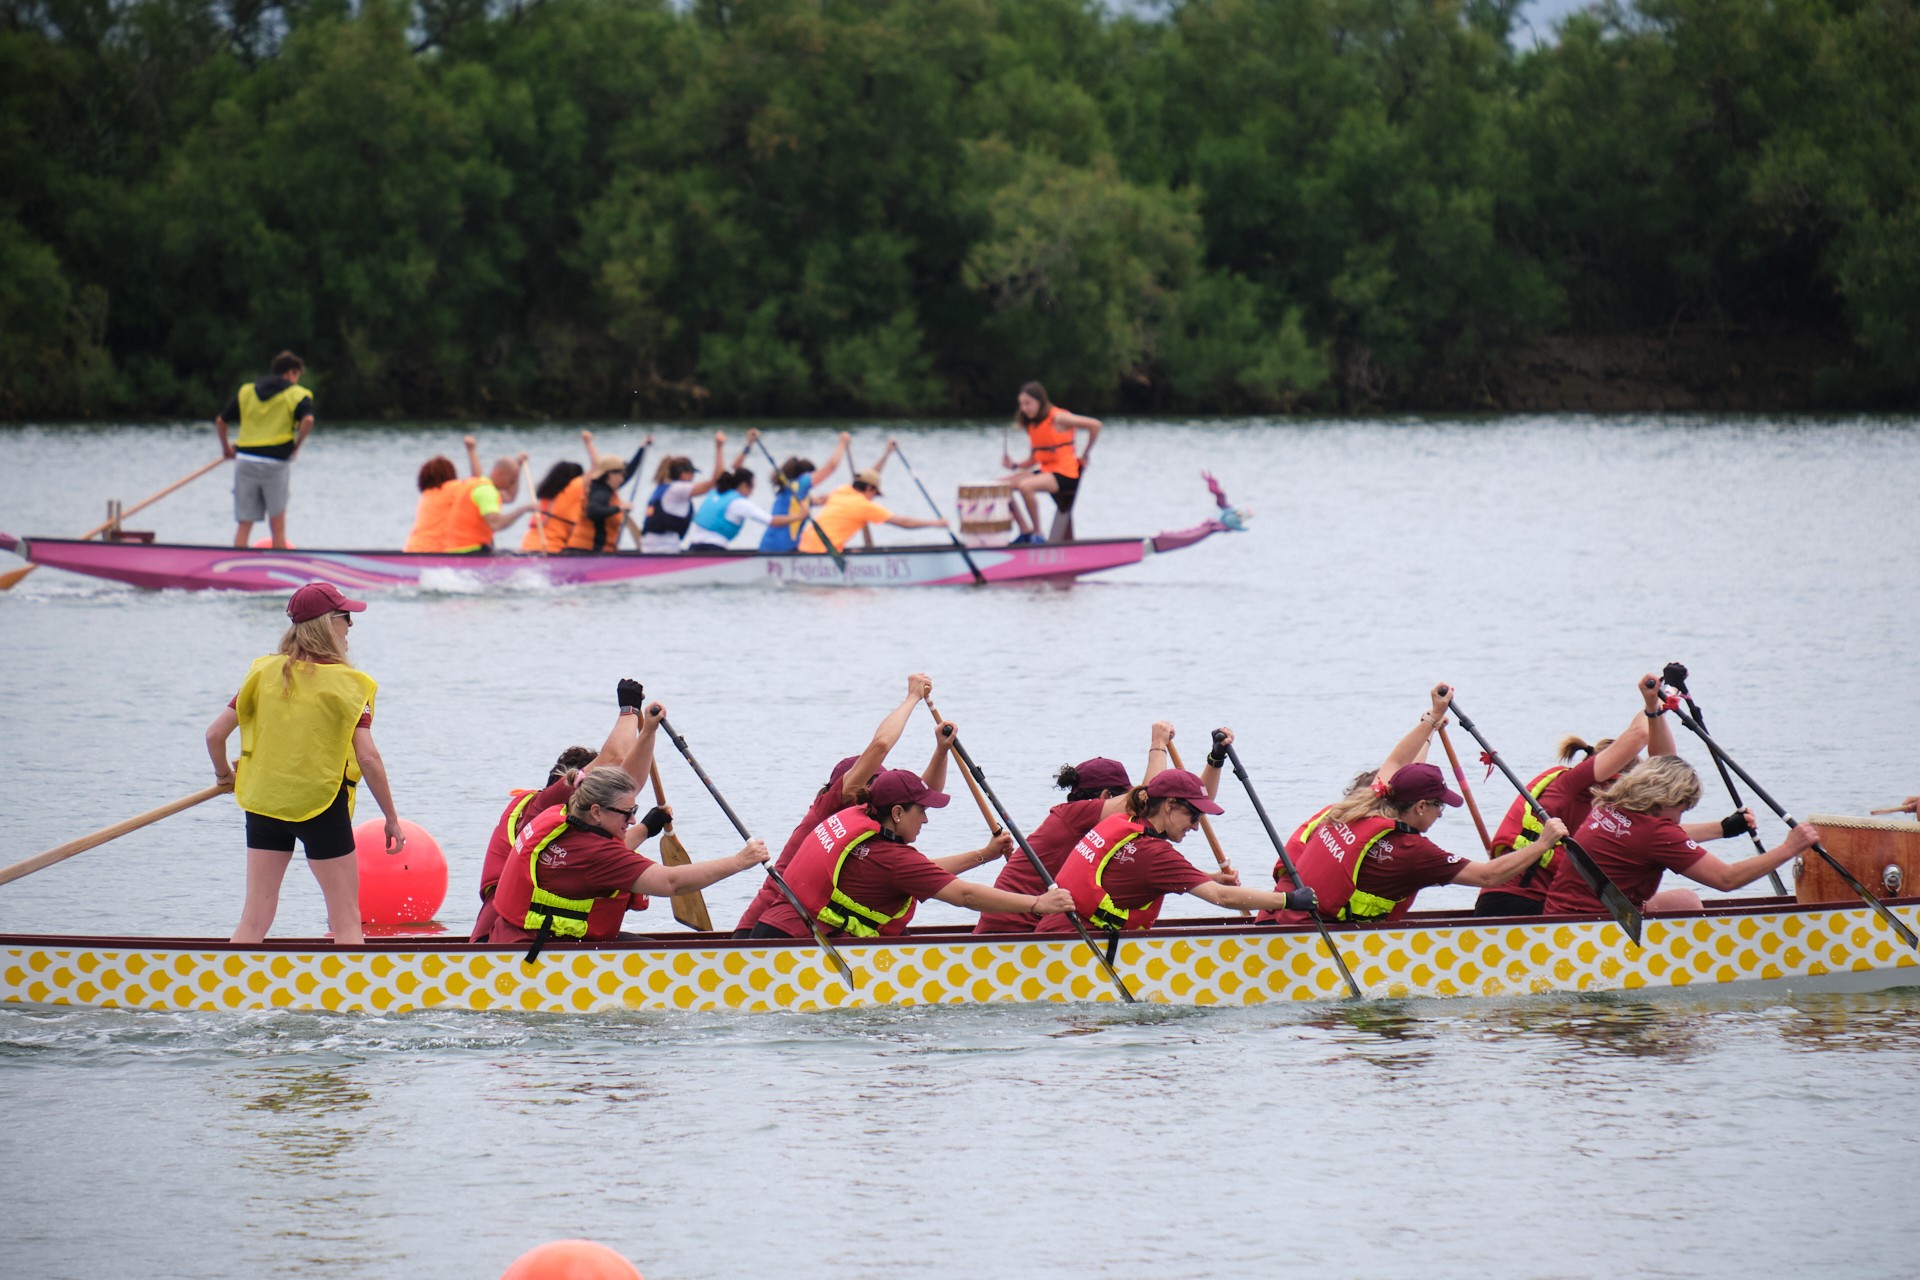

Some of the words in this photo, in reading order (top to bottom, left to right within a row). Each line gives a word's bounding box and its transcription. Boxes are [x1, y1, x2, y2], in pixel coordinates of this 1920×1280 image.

[814, 823, 835, 854] KAYAKA
[827, 814, 847, 839] GETXO
[1334, 822, 1356, 845] ETXO
[1074, 840, 1096, 863] AYAKA
[1318, 826, 1345, 863] KAYAKA
